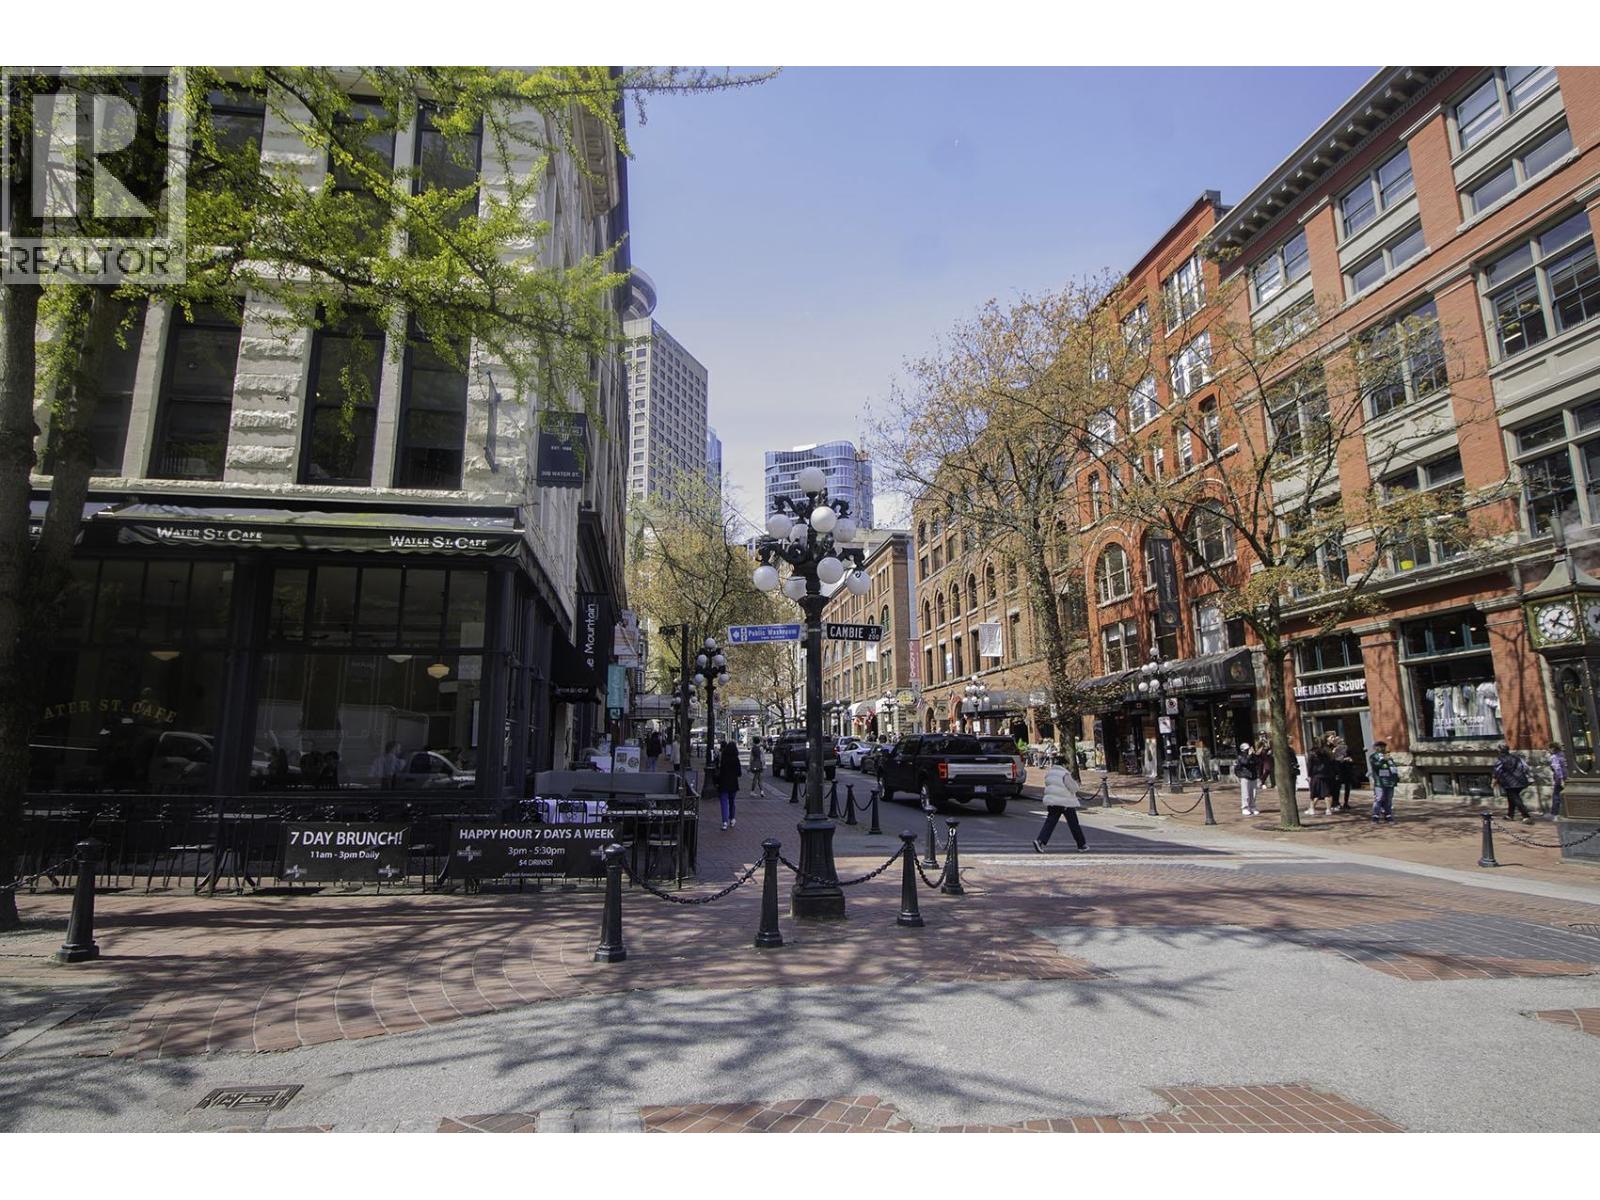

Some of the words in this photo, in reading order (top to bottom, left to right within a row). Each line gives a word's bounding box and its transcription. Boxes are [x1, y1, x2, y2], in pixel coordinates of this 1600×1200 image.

[584, 603, 596, 655] Mountain
[748, 629, 766, 637] Public
[767, 628, 797, 637] Washroom
[830, 625, 864, 638] CAMBIE
[1293, 685, 1308, 697] THE
[1308, 682, 1338, 696] LATEST
[1338, 678, 1366, 692] SCOOP
[290, 831, 300, 845] 7
[302, 831, 334, 845] DAY
[336, 831, 403, 845] BRUNCH!
[459, 829, 498, 839] HAPPY
[499, 829, 532, 839] HOUR
[534, 829, 541, 839] 7
[543, 829, 572, 839] DAYS
[573, 829, 582, 839] A
[584, 829, 614, 839] WEEK
[310, 850, 333, 859] 11am
[339, 850, 358, 860] 3pm
[359, 850, 380, 860] Daily
[508, 846, 527, 856] 3pm
[534, 846, 566, 856] 5:30pm
